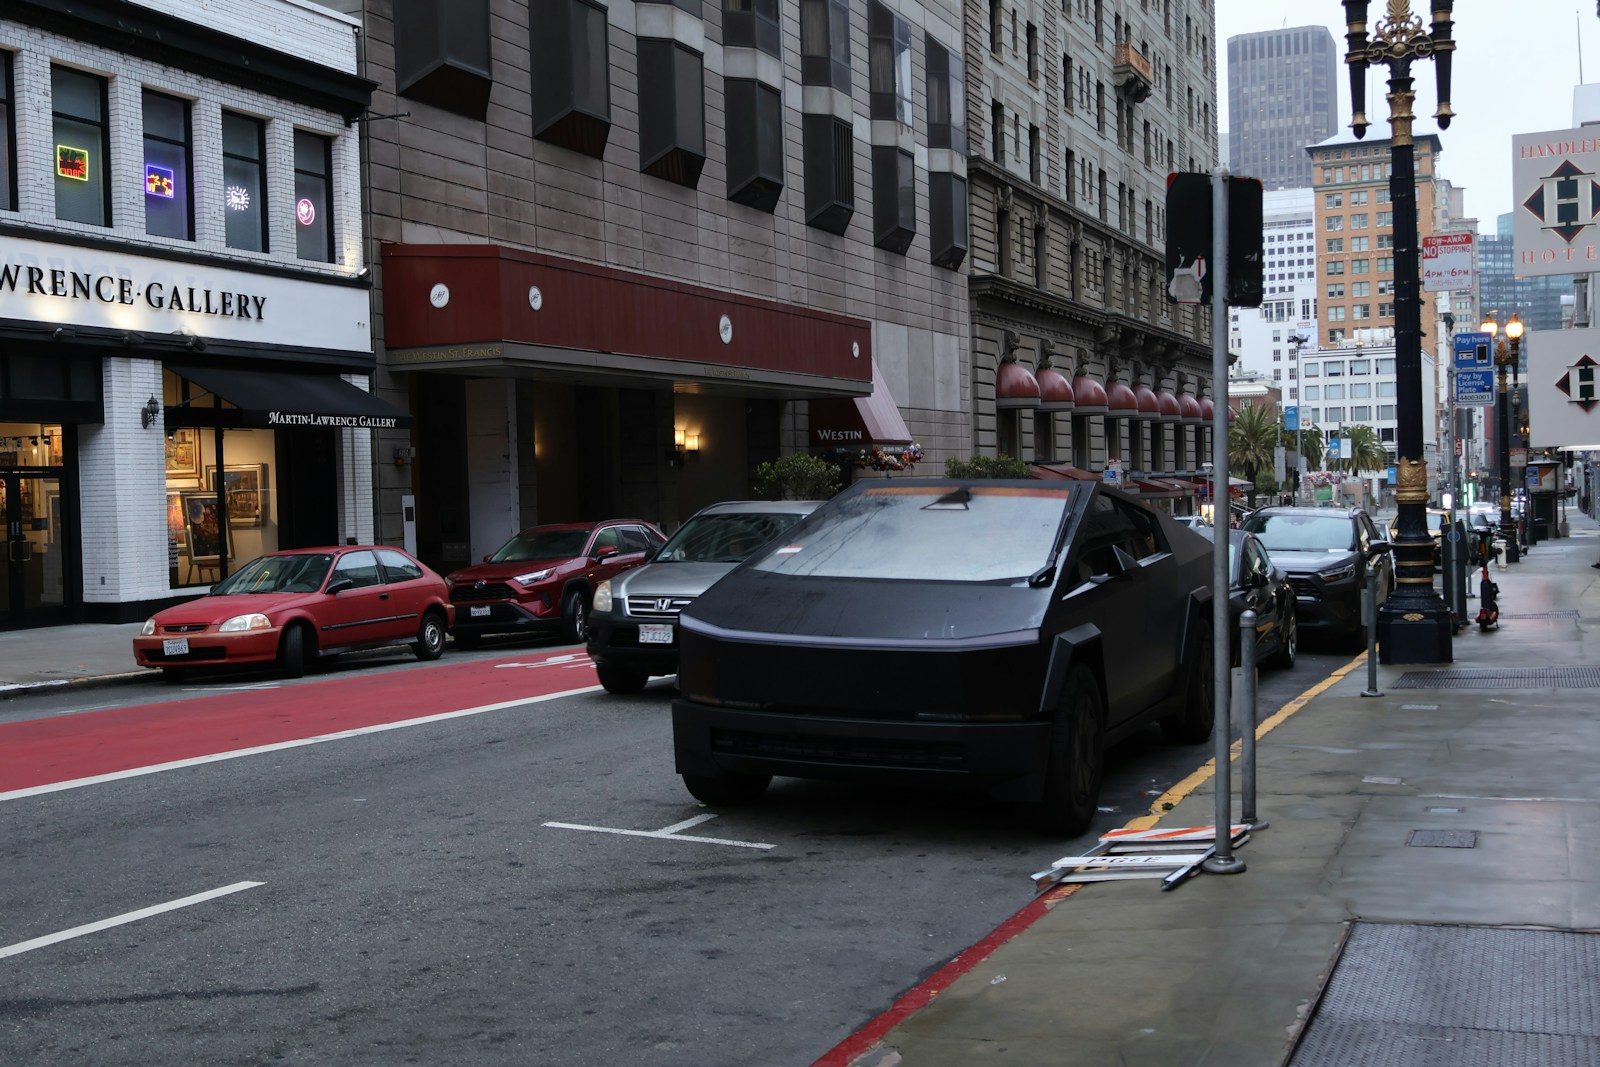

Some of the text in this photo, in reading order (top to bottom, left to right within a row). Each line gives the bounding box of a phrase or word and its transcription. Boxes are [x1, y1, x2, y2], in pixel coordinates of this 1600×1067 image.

[1423, 245, 1470, 258] NO STOPPING
[1473, 373, 1482, 381] by
[358, 415, 396, 428] GALLERY
[817, 429, 862, 441] WESTIN
